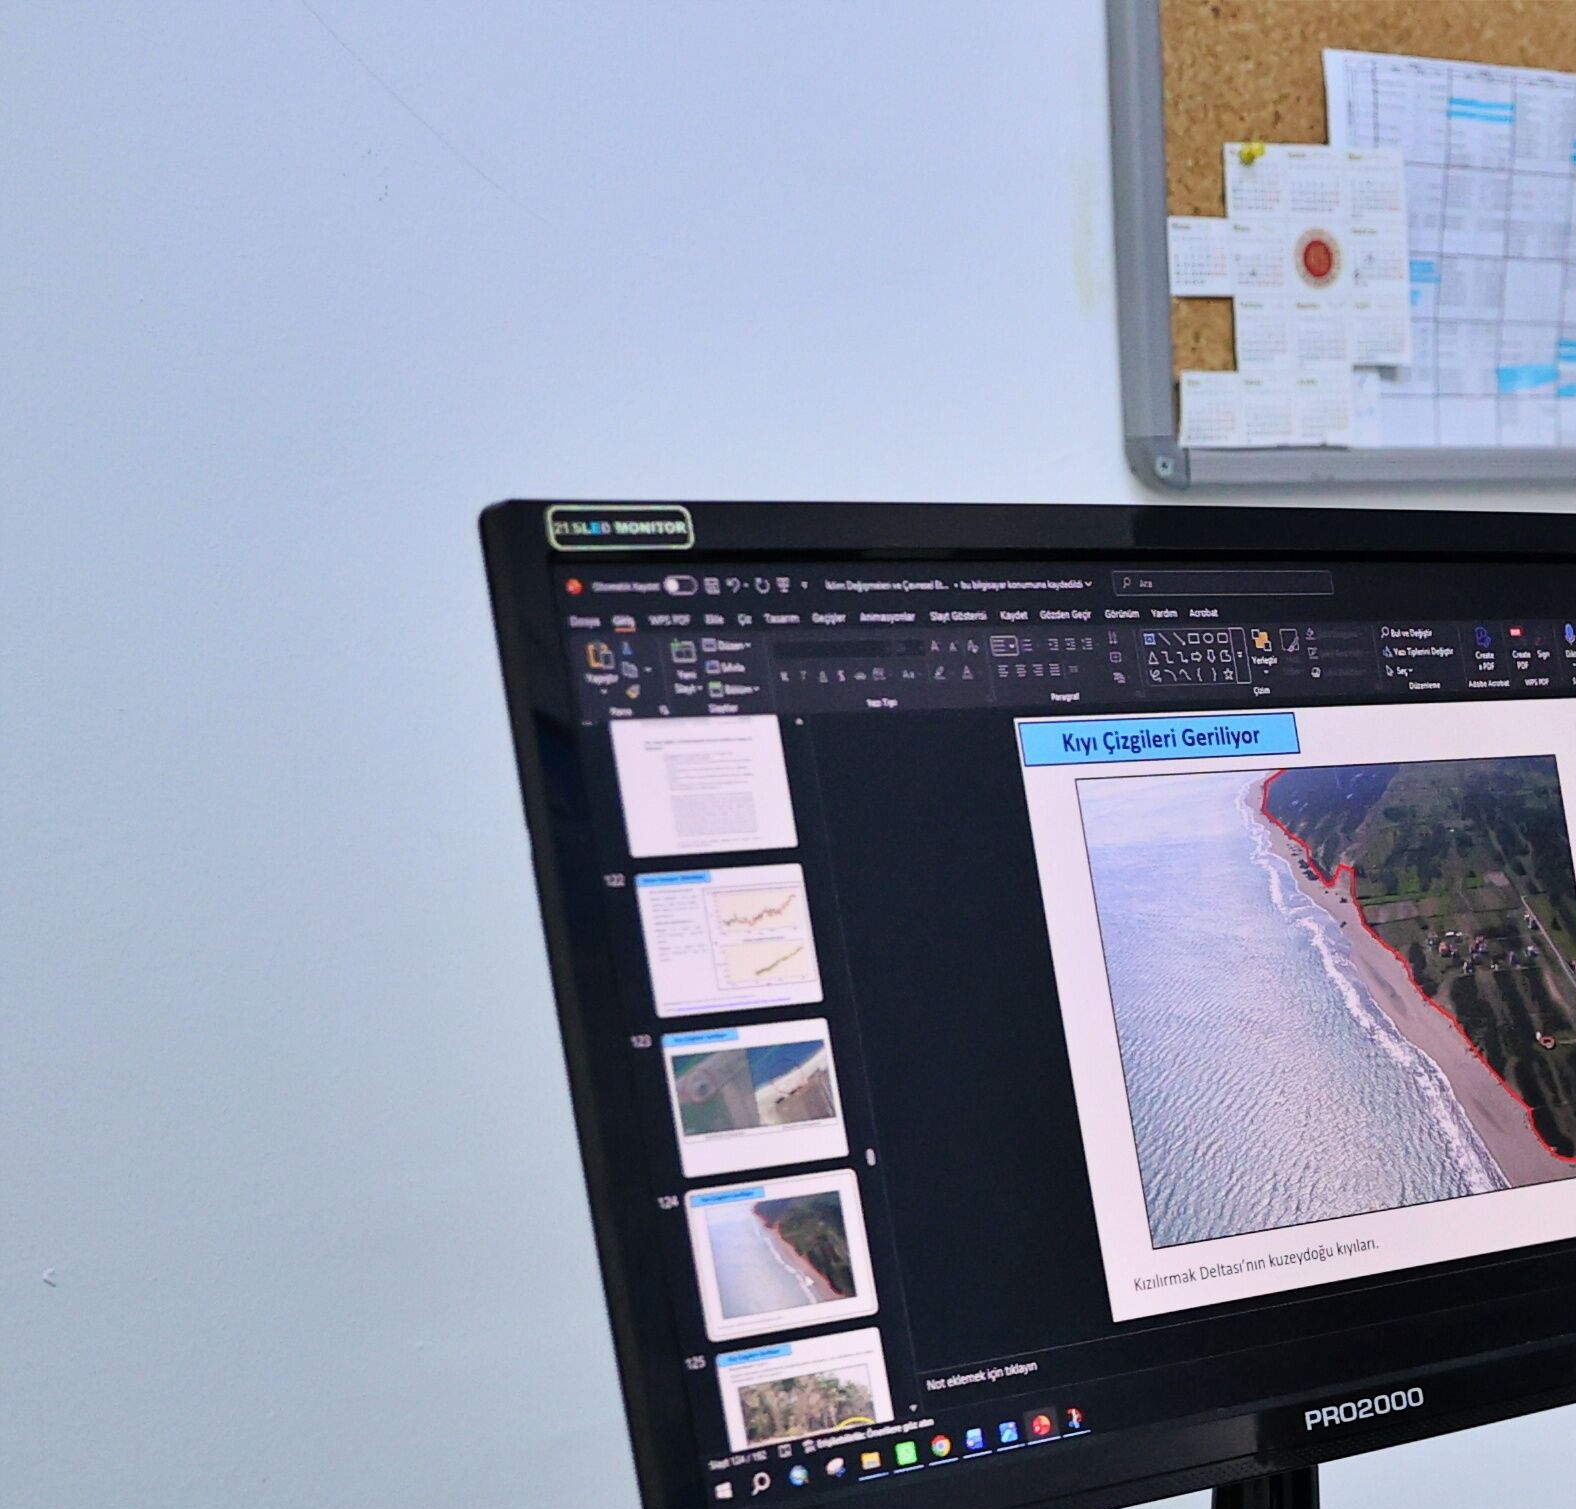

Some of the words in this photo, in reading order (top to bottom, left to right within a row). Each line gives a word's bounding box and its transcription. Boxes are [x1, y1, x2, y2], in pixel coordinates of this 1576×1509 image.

[1062, 732, 1098, 755] Kıyı
[1103, 729, 1176, 754] Çizgileri
[1182, 726, 1260, 753] Geriliyor
[604, 873, 626, 887] 122
[630, 1034, 652, 1048] 123
[658, 1195, 680, 1210] 124
[1133, 1268, 1197, 1292] Kızılırmak
[1269, 1245, 1334, 1267] kuzeydoğu
[1336, 1238, 1380, 1257] kıyıları.
[685, 1355, 707, 1370] 125
[926, 1377, 945, 1391] Not
[947, 1370, 985, 1388] eklemek
[986, 1365, 1004, 1383] için
[1305, 1386, 1425, 1431] PRO2000
